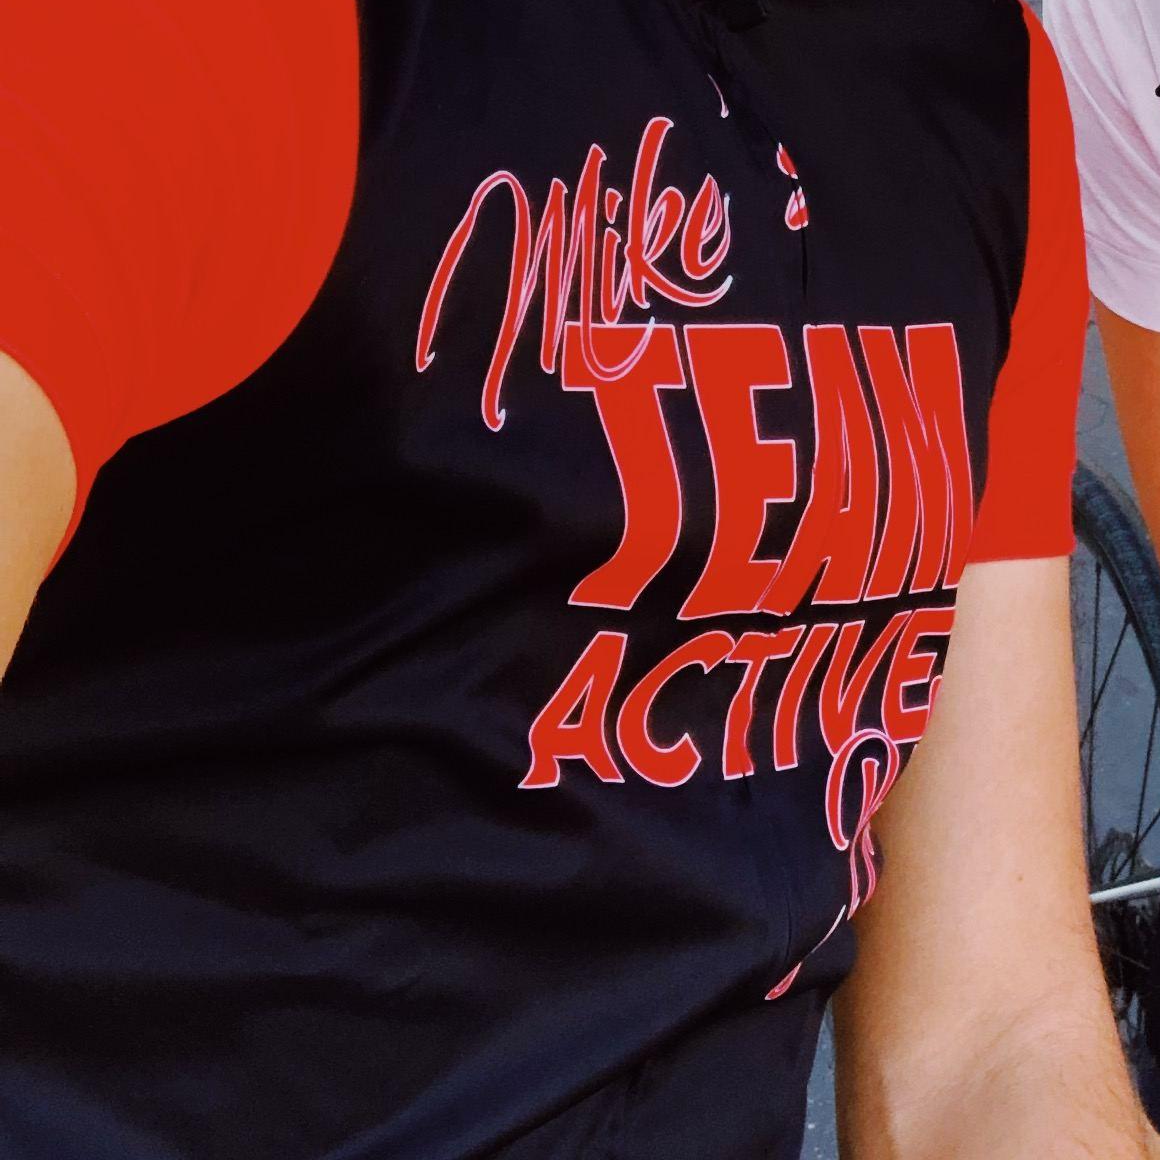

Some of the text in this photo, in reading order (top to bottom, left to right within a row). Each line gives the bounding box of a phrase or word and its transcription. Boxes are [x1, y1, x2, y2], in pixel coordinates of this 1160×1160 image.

[415, 115, 734, 433] Mike
[561, 322, 975, 621] TEAM
[517, 605, 957, 790] ACTIVE
